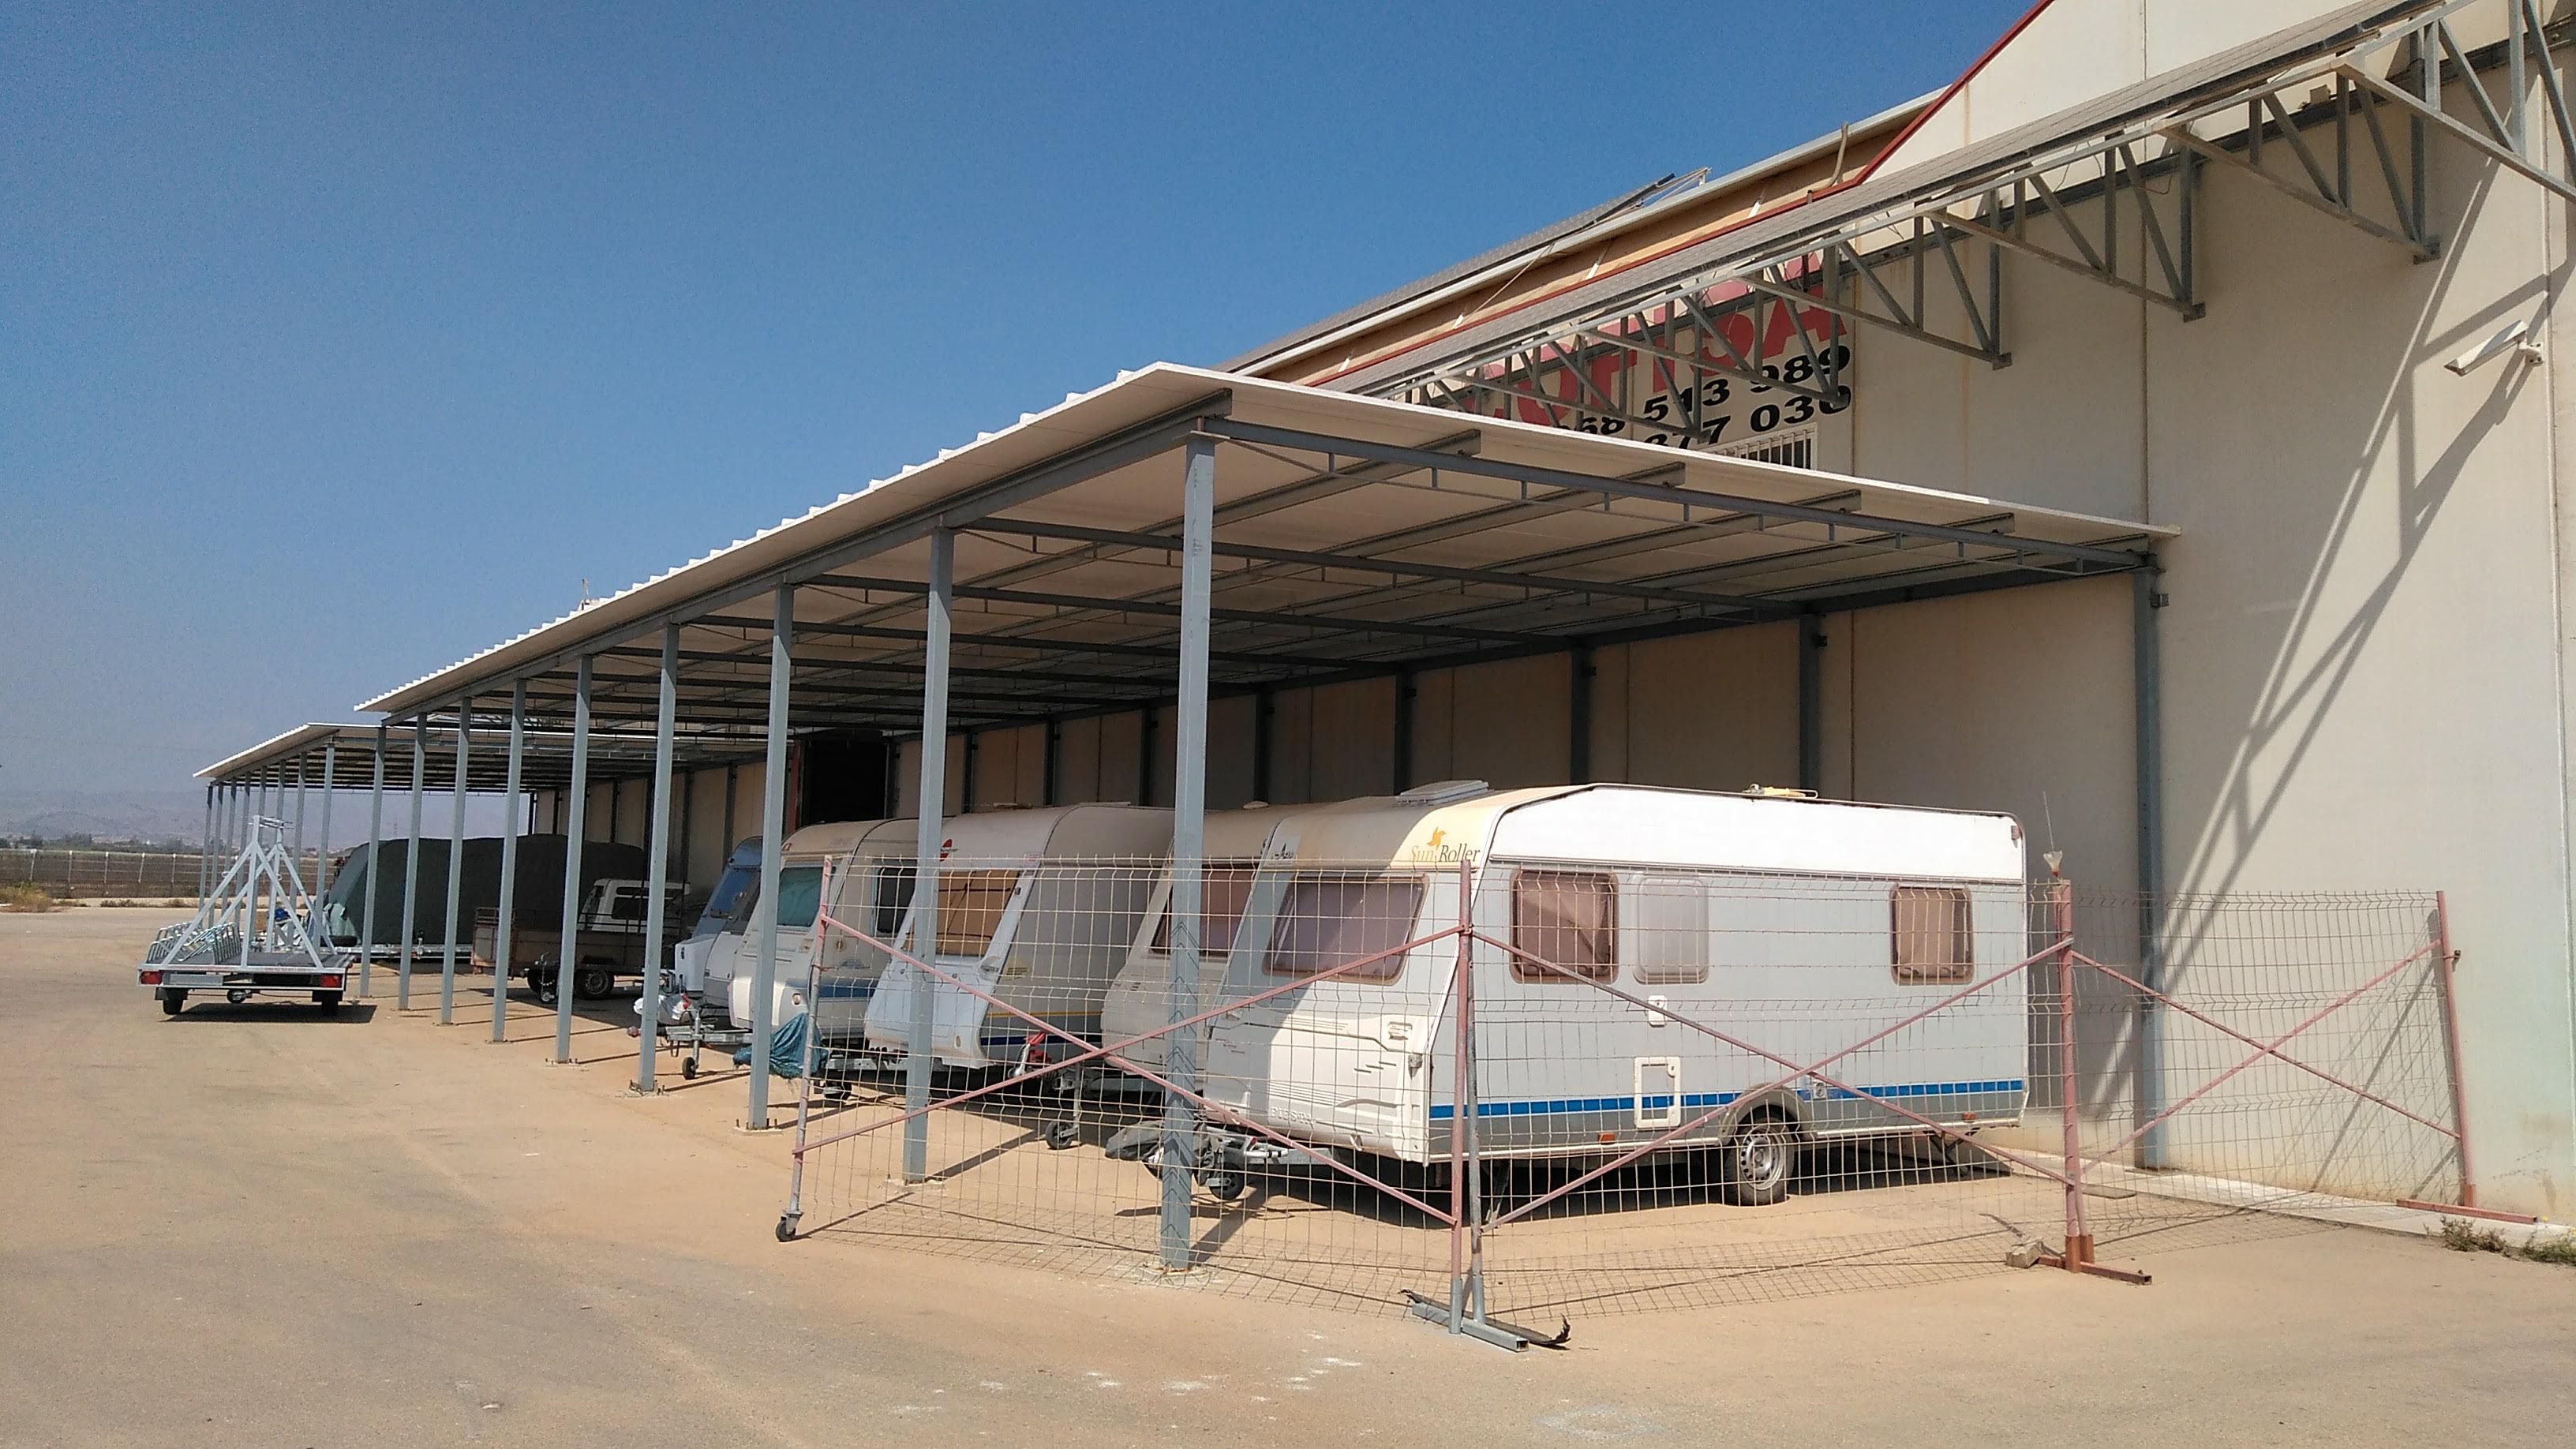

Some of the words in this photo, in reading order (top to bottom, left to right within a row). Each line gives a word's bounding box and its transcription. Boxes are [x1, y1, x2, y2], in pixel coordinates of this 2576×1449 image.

[1644, 379, 1730, 421] 513
[1750, 346, 1850, 393] 989
[1410, 845, 1434, 862] Sun
[1439, 843, 1481, 863] Roller
